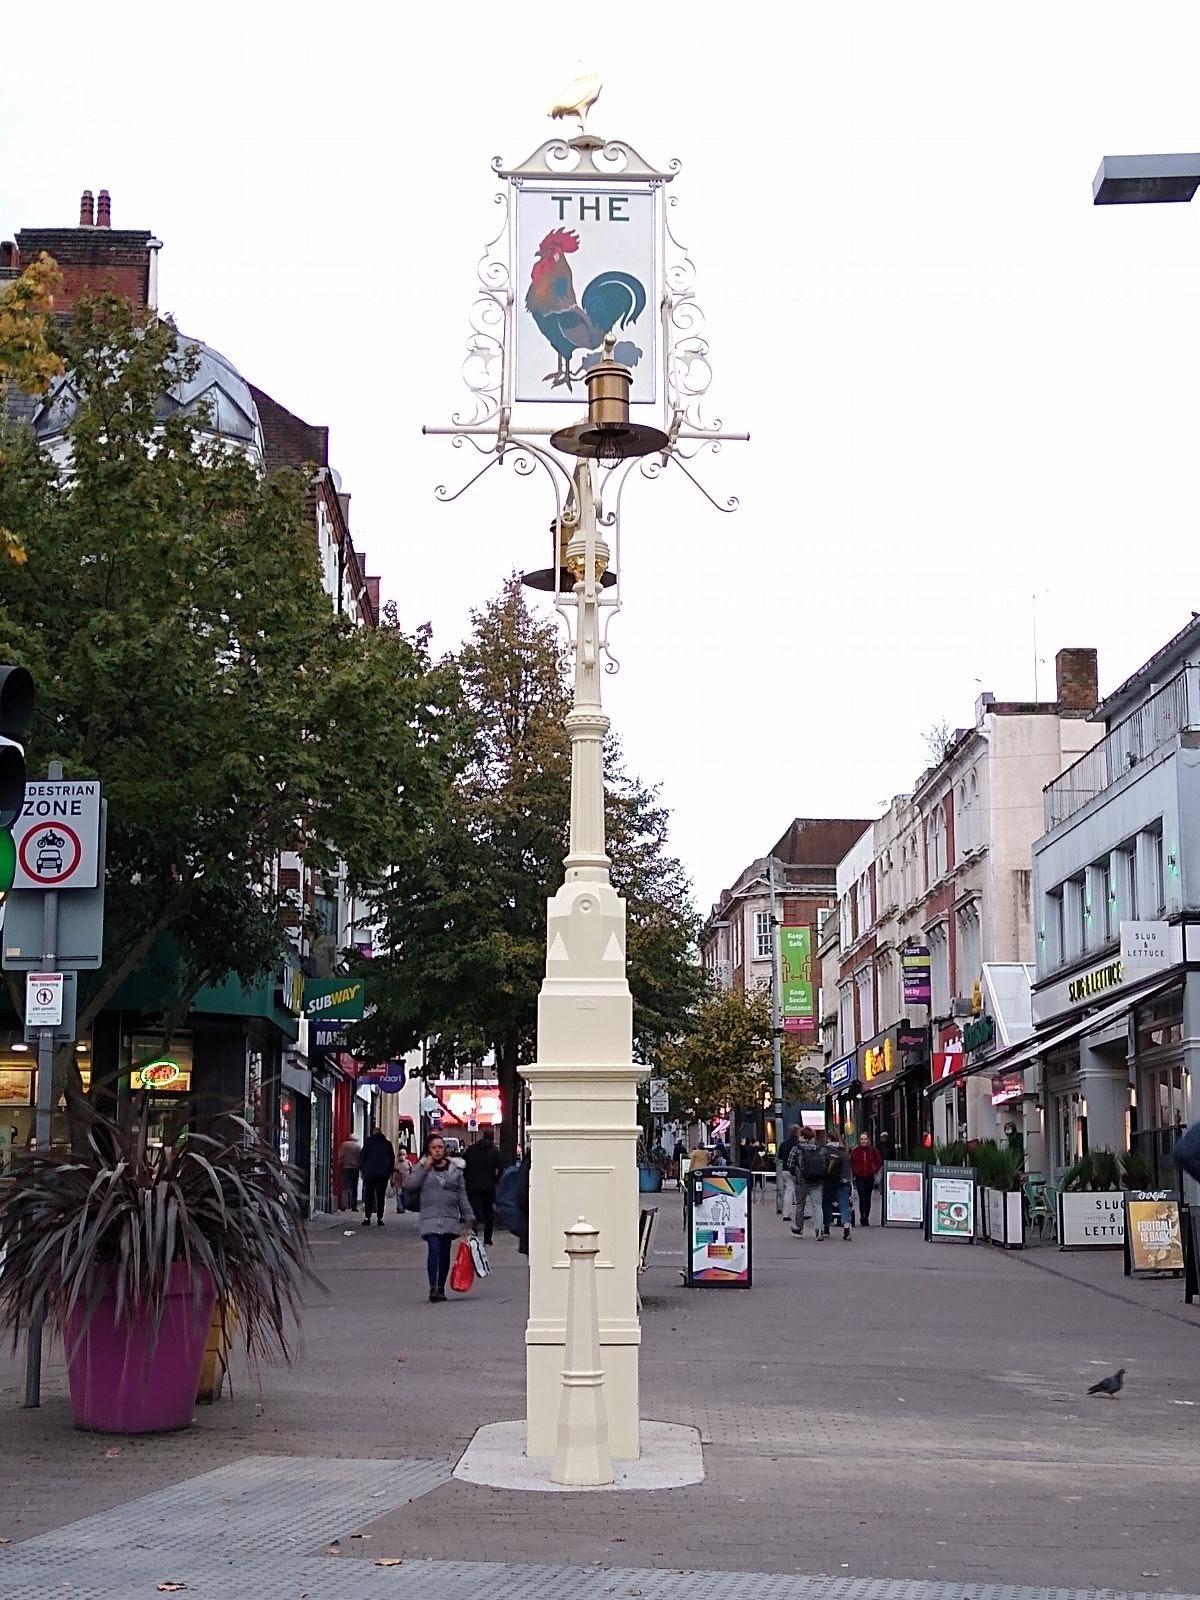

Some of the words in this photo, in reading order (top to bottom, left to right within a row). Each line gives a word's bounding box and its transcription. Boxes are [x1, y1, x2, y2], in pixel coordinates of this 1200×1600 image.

[551, 196, 630, 222] THE
[25, 786, 95, 796] DESTRIAN
[23, 800, 82, 816] ZONE
[787, 933, 803, 941] Keep
[1127, 949, 1165, 957] LETTUCE
[1069, 977, 1086, 1002] SLUG
[1091, 960, 1123, 994] LETTUCE
[789, 989, 805, 997] Keep
[306, 984, 360, 1014] SUBWAY
[1109, 1213, 1115, 1222] &
[1137, 1220, 1172, 1231] FOOTBALL
[1085, 1226, 1124, 1236] LETTU
[1141, 1232, 1149, 1242] IS
